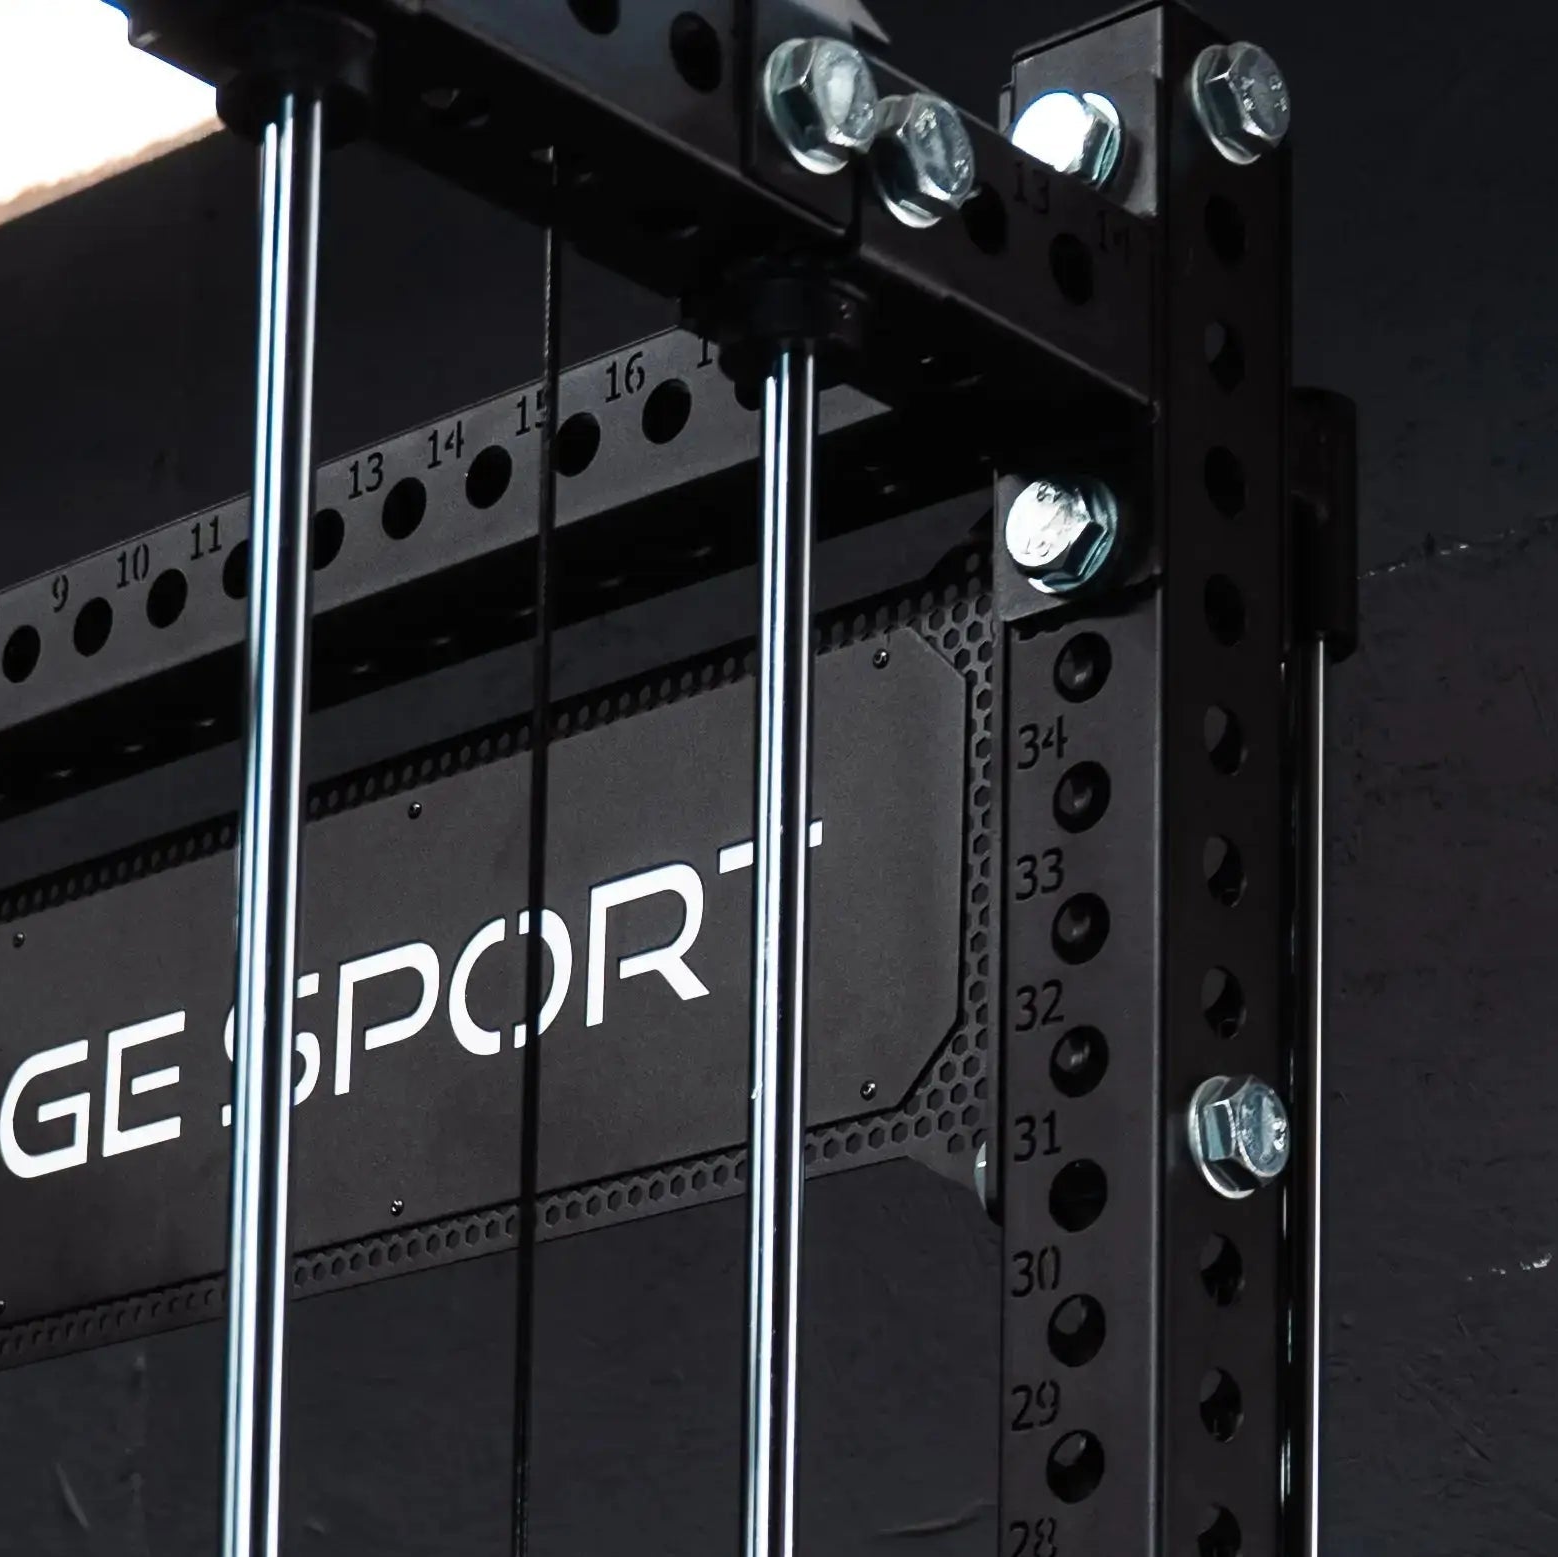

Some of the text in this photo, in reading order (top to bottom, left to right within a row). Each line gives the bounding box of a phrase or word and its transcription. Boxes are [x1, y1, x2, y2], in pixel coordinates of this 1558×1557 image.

[52, 575, 69, 612] 9
[116, 545, 150, 589] 10
[189, 515, 223, 561] 11
[348, 452, 385, 500] 13
[426, 420, 465, 469] 14
[605, 353, 645, 403] 16
[1017, 717, 1068, 769] 34
[1015, 848, 1063, 900] 33
[222, 820, 823, 1127] POR
[1015, 980, 1064, 1031] 32
[1013, 1111, 1061, 1162] 31
[1012, 1246, 1060, 1298] 30
[1011, 1381, 1060, 1431] 29
